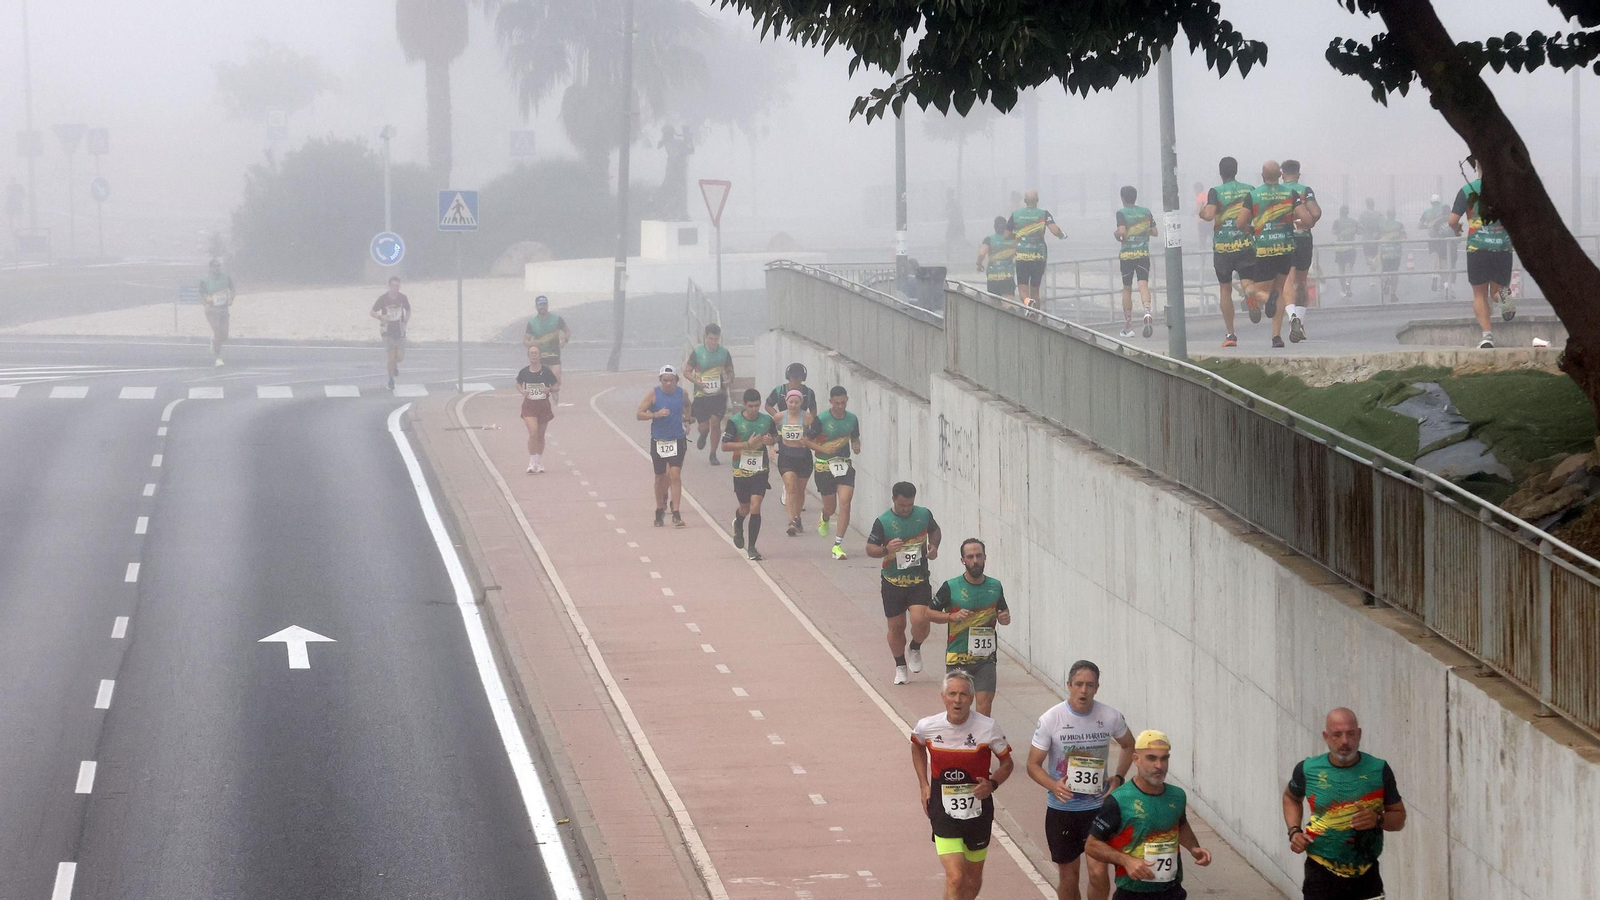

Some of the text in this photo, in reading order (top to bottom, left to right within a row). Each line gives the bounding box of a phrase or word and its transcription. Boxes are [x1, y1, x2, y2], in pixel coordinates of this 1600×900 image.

[747, 458, 757, 466] 66
[834, 463, 844, 471] 71
[905, 553, 917, 563] 99
[974, 638, 992, 649] 315
[944, 769, 965, 781] cdp
[1074, 770, 1099, 785] 336
[950, 796, 975, 811] 337
[1156, 857, 1173, 872] 79
